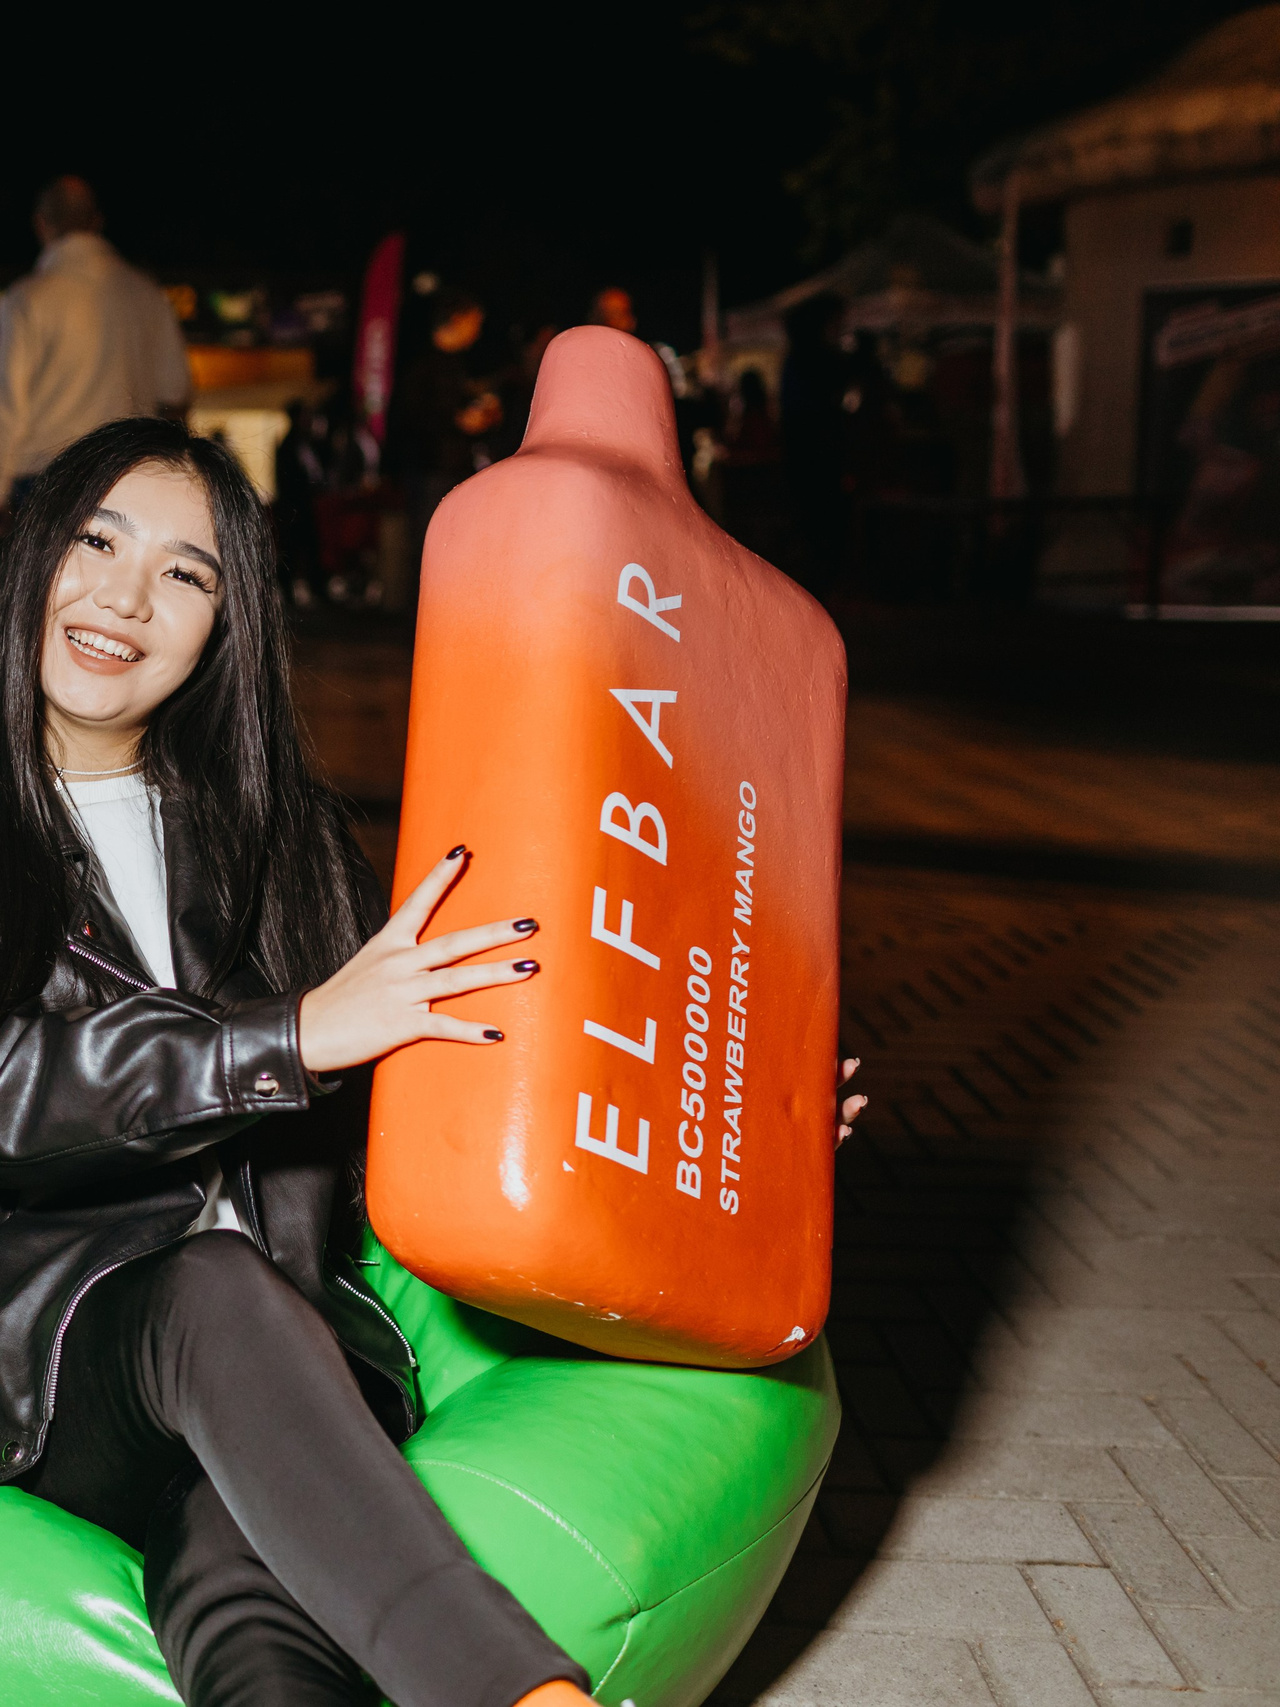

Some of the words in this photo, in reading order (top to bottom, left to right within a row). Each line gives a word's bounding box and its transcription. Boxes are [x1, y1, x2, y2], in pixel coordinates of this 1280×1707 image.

[733, 780, 758, 926] MANGO
[675, 945, 713, 1200] BC500000
[719, 928, 751, 1216] STRAWBERRY
